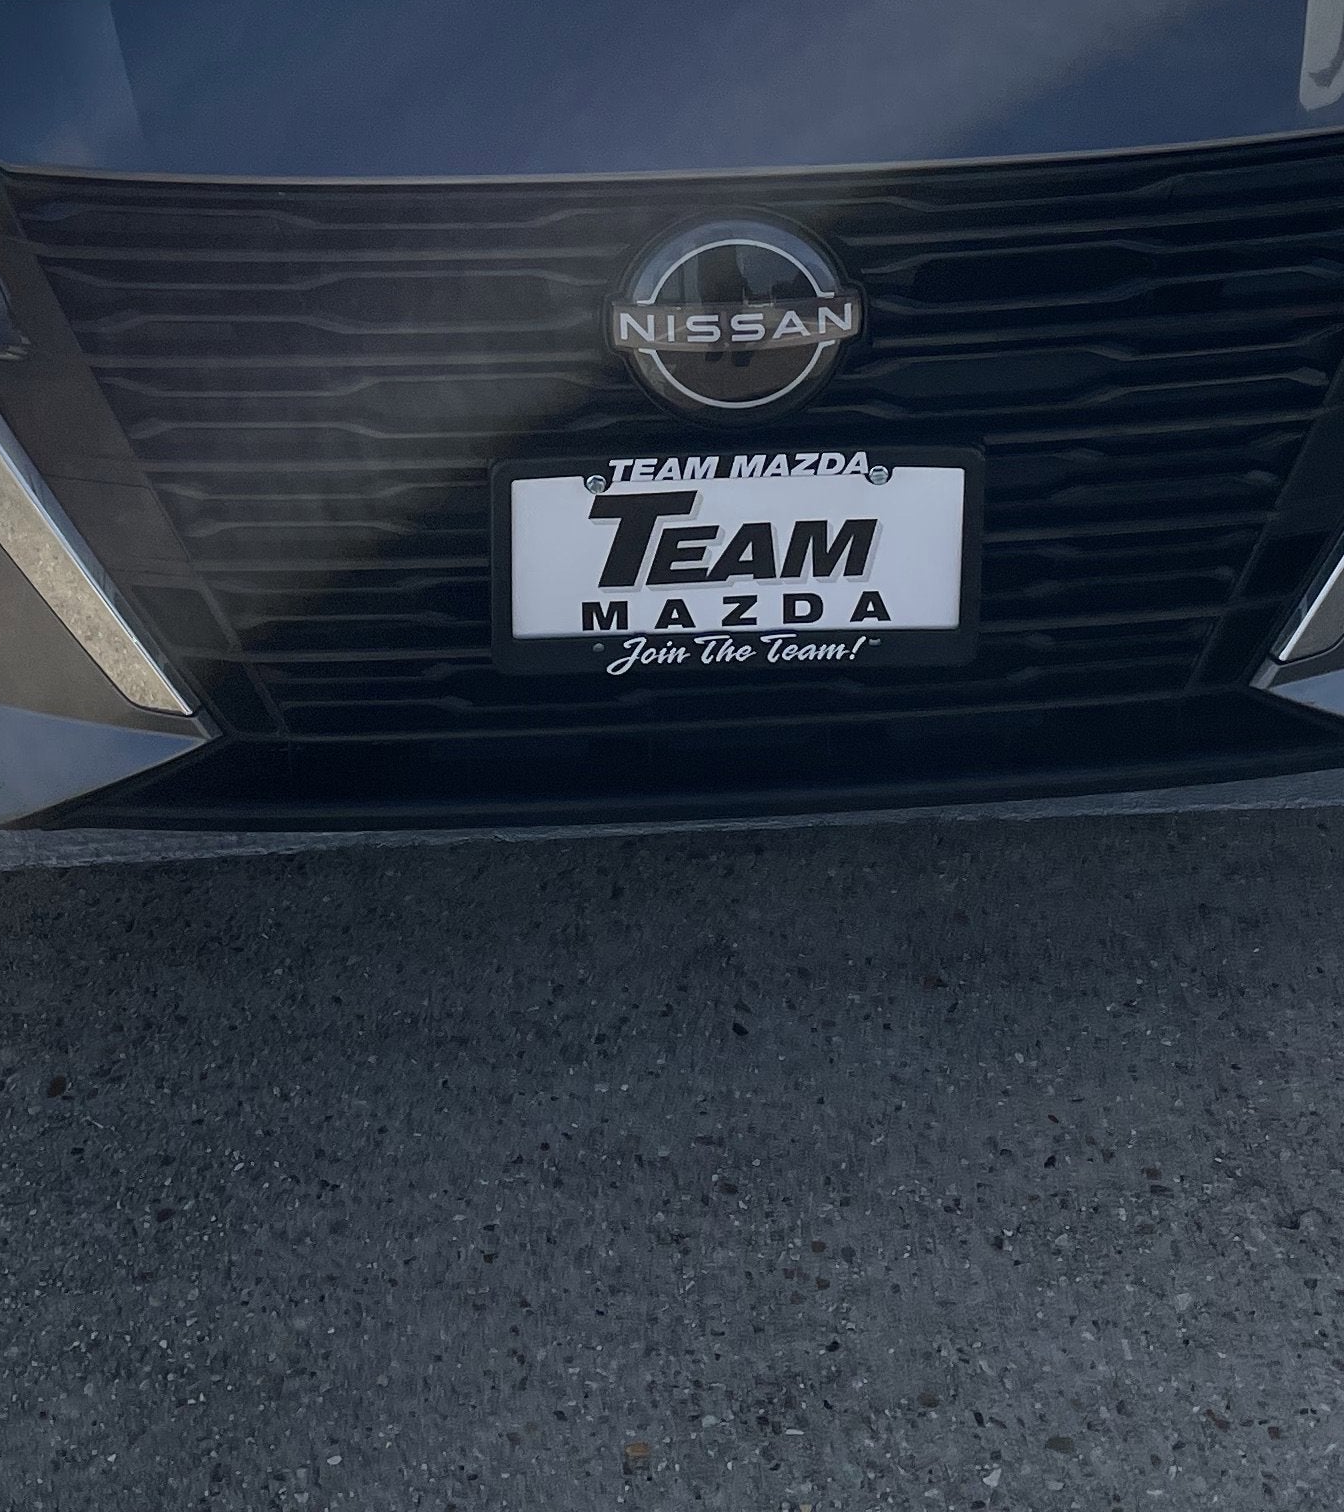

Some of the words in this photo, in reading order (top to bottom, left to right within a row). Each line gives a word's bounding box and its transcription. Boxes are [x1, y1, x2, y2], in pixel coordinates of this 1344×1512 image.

[619, 303, 852, 343] NISSAN
[608, 457, 720, 482] TEAM
[729, 451, 870, 480] MAZDA
[581, 591, 892, 632] MAZDA
[606, 636, 690, 676] Join
[693, 634, 756, 665] The
[760, 633, 867, 664] Team!
